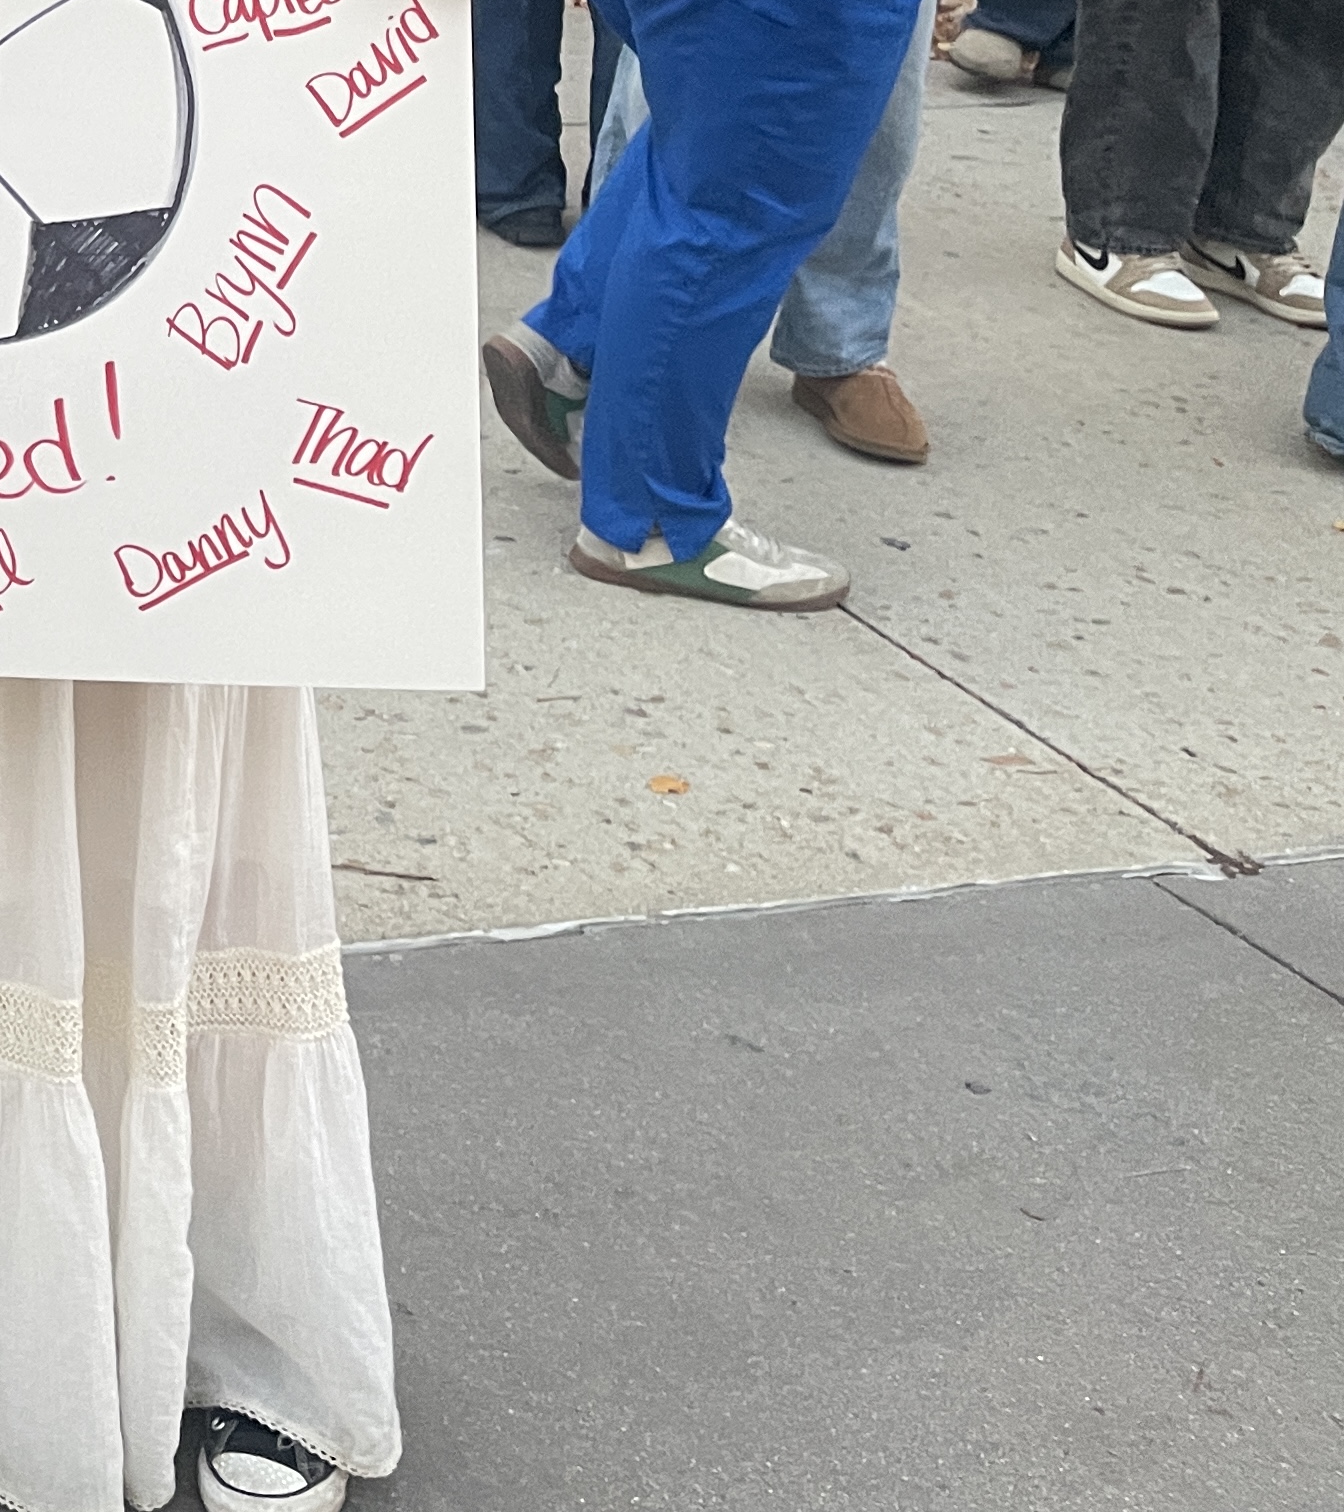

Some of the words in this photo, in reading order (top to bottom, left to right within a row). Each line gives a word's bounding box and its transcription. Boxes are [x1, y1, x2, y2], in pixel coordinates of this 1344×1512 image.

[167, 183, 311, 371] Brynn
[293, 398, 434, 492] Thad
[113, 489, 292, 597] Danny
